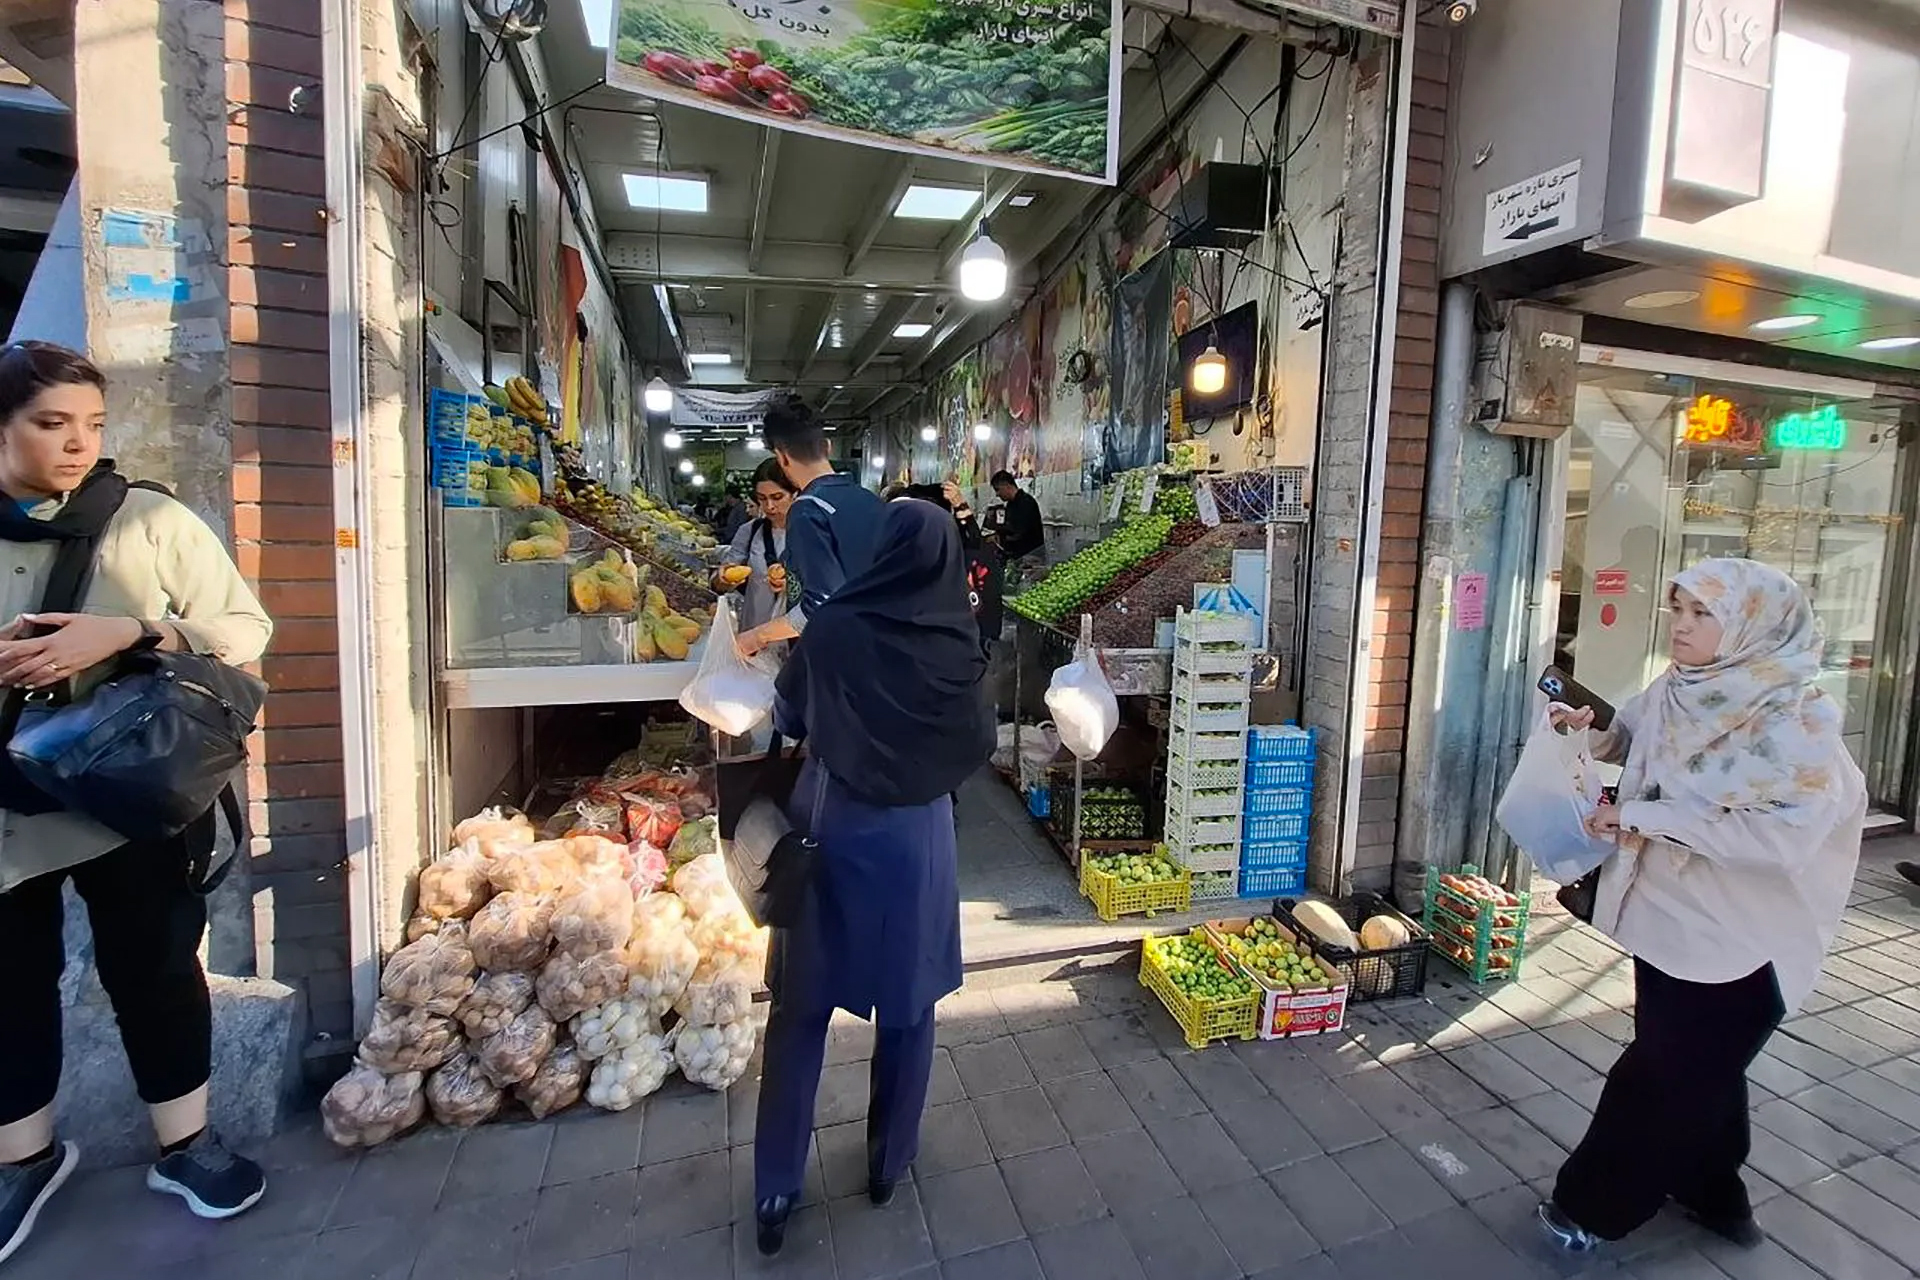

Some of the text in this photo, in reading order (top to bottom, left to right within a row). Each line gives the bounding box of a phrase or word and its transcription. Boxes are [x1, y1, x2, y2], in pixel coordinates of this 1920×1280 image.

[1057, 1, 1093, 21] انواع
[779, 15, 831, 38] بدون
[974, 20, 1055, 44] انتهای بازار
[1498, 190, 1566, 230] انتهای بازار
